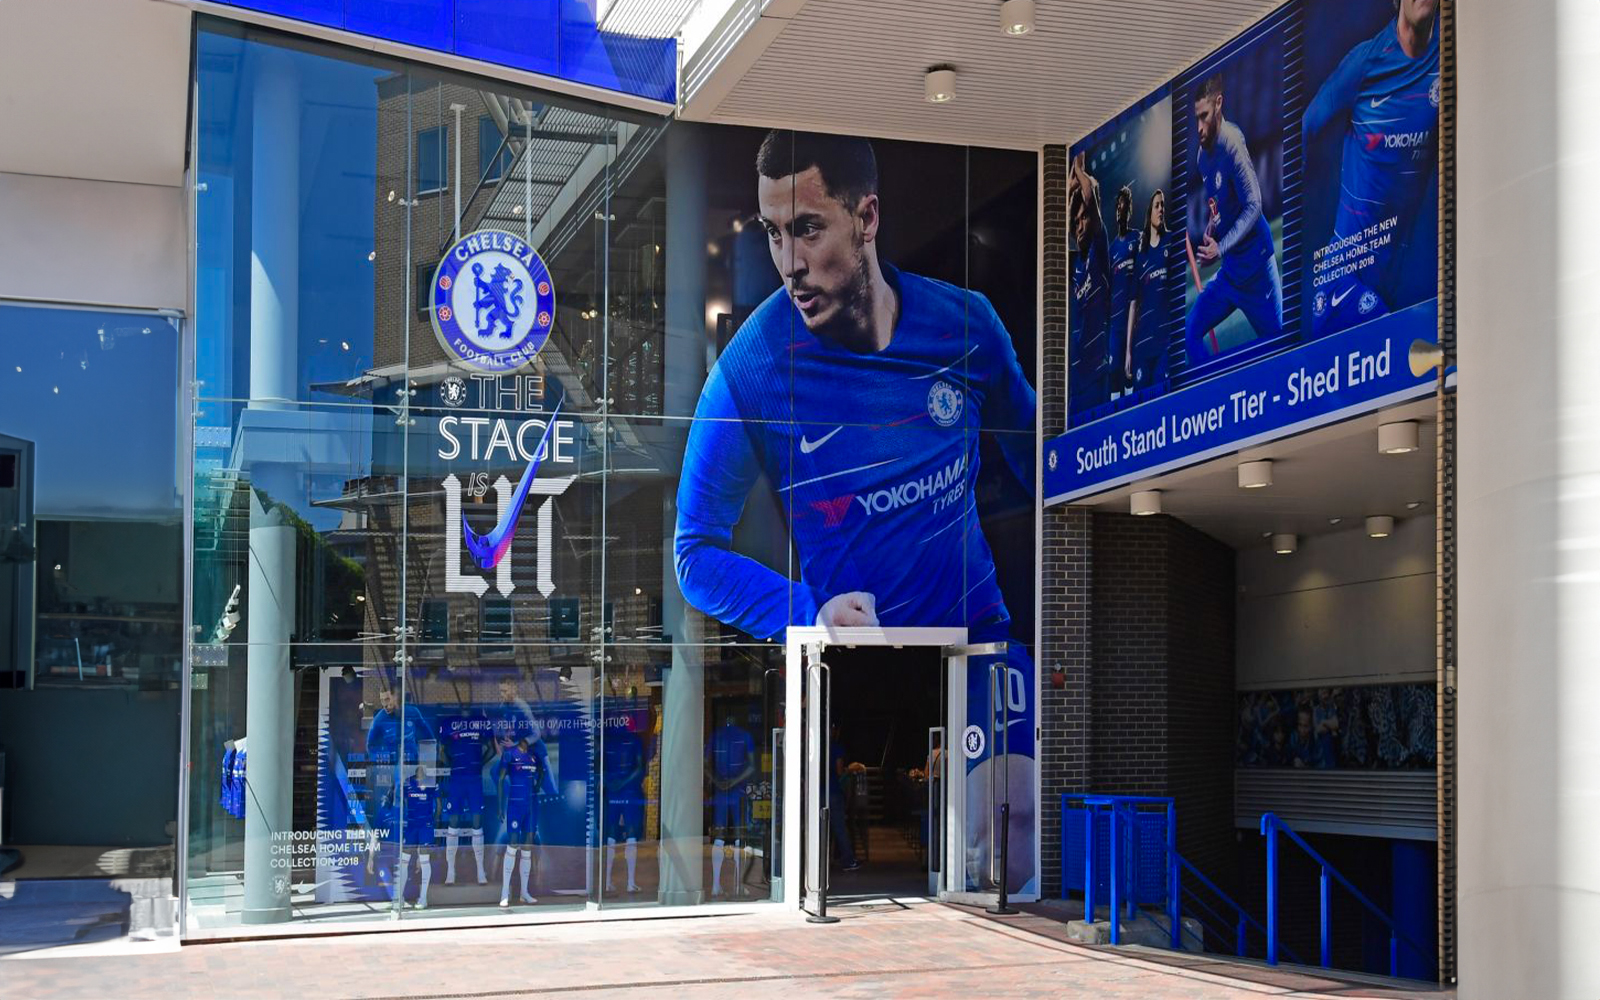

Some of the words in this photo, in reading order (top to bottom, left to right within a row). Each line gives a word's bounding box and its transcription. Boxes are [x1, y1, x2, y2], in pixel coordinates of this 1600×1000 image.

[455, 233, 534, 268] CHELSEA
[1313, 232, 1362, 260] INTRODUCING
[1363, 224, 1378, 239] THE
[1379, 215, 1398, 232] NEW
[1313, 254, 1344, 274] CHELSEA
[1346, 243, 1368, 260] HOME
[1369, 233, 1391, 249] TEAM
[1313, 261, 1357, 287] COLLECTION
[1359, 255, 1375, 269] 2018
[453, 338, 504, 366] FOOTBALL
[510, 341, 535, 363] CLUB
[470, 373, 543, 411] THE
[1076, 440, 1118, 475] South
[1122, 416, 1166, 459] Stand
[1172, 406, 1226, 443] Lower
[1230, 389, 1267, 424] Tier
[1287, 356, 1339, 406] Shed
[1348, 338, 1391, 386] End
[438, 416, 574, 463] STAGE
[467, 472, 488, 496] IS
[933, 478, 965, 515] TYRES
[441, 473, 578, 598] LIT
[989, 664, 1026, 713] 10
[270, 844, 317, 855] CHELSEA
[320, 843, 350, 853] HOME
[353, 842, 381, 852] TEAM
[271, 829, 342, 841] INTRODUCING
[345, 829, 365, 840] THE
[366, 829, 390, 839] NEW
[270, 857, 335, 868] COLLECTION
[338, 857, 359, 866] 2018
